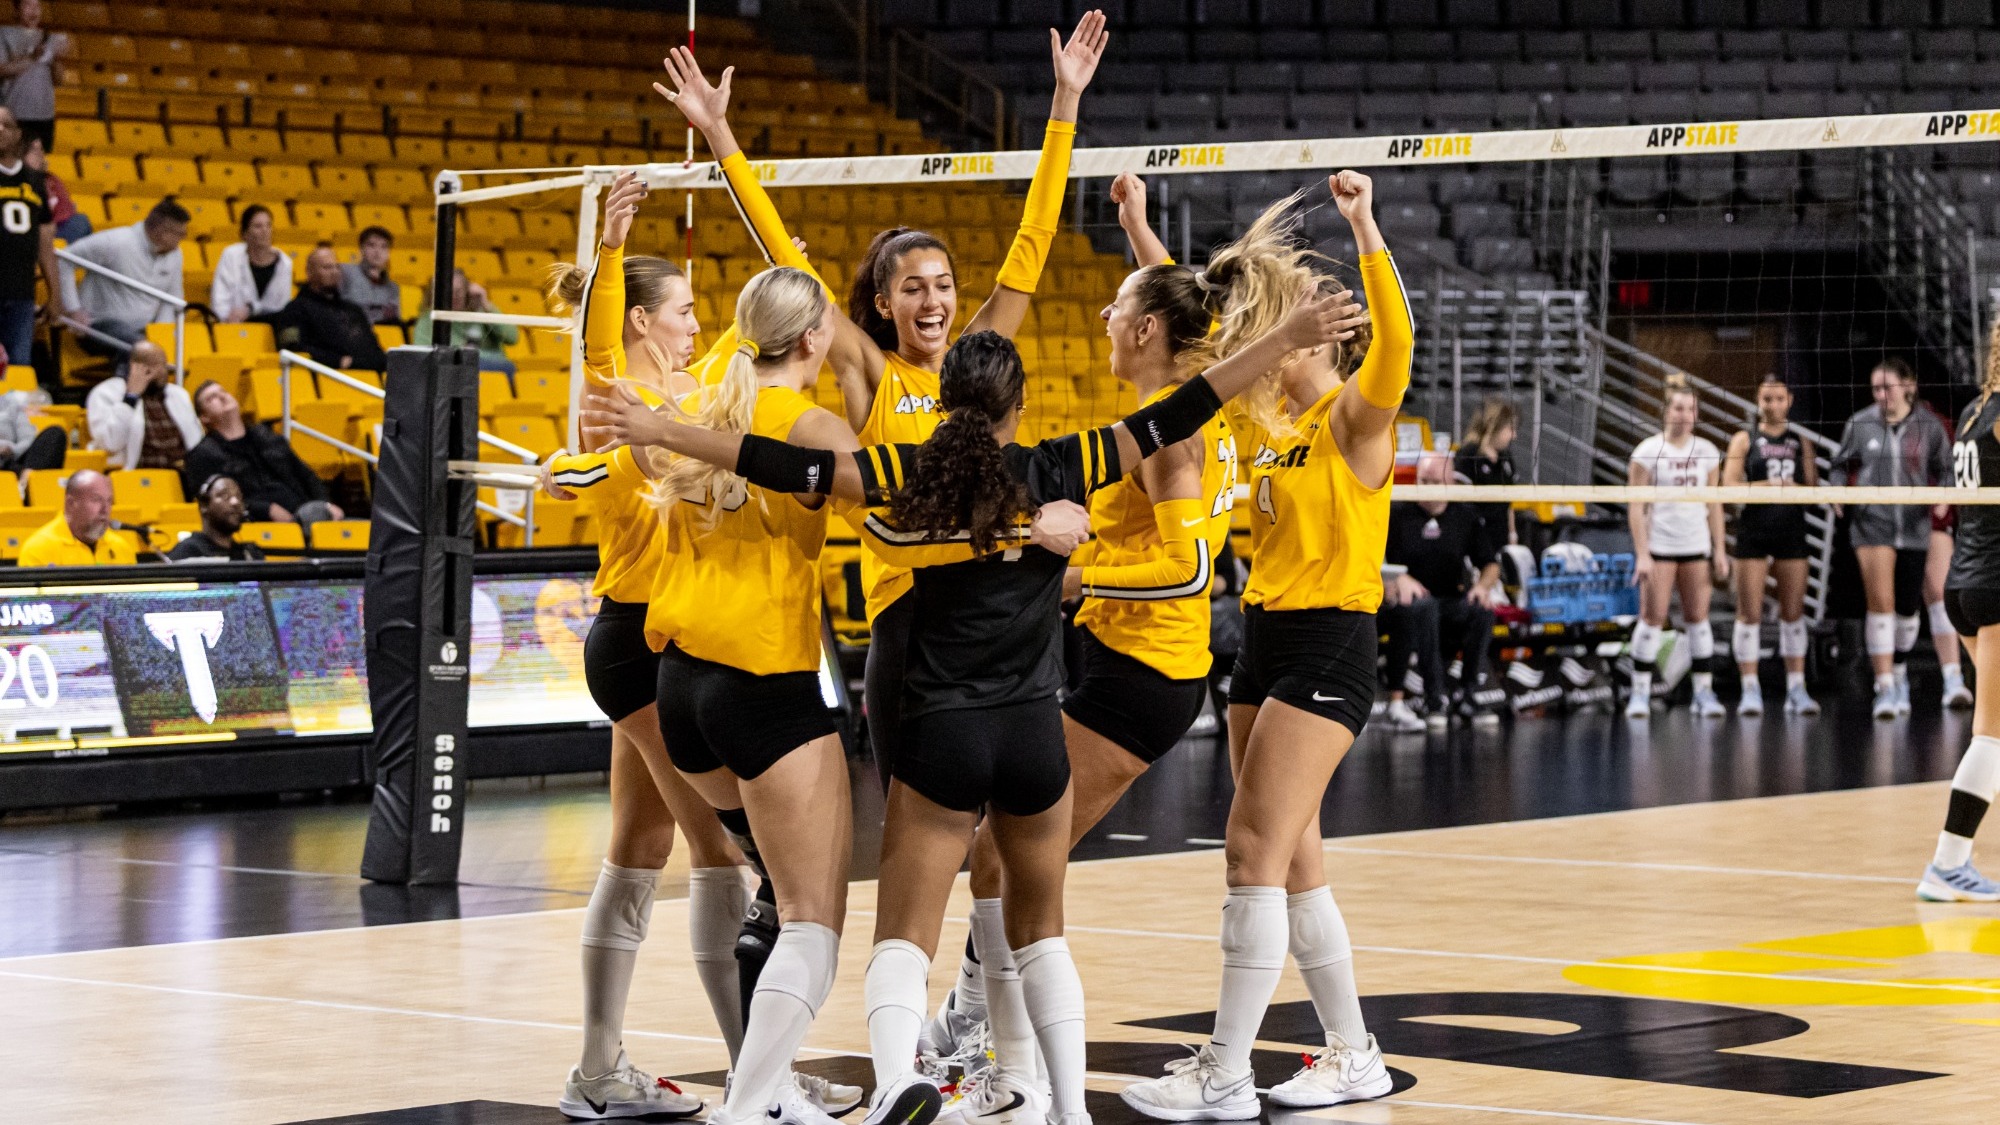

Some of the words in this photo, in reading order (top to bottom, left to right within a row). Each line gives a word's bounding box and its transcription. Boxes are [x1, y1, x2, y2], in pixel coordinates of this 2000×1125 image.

[1953, 440, 1981, 488] 20
[1257, 476, 1276, 525] 4
[0, 603, 55, 626] JANS
[0, 645, 59, 708] 20
[430, 734, 455, 833] senoh
